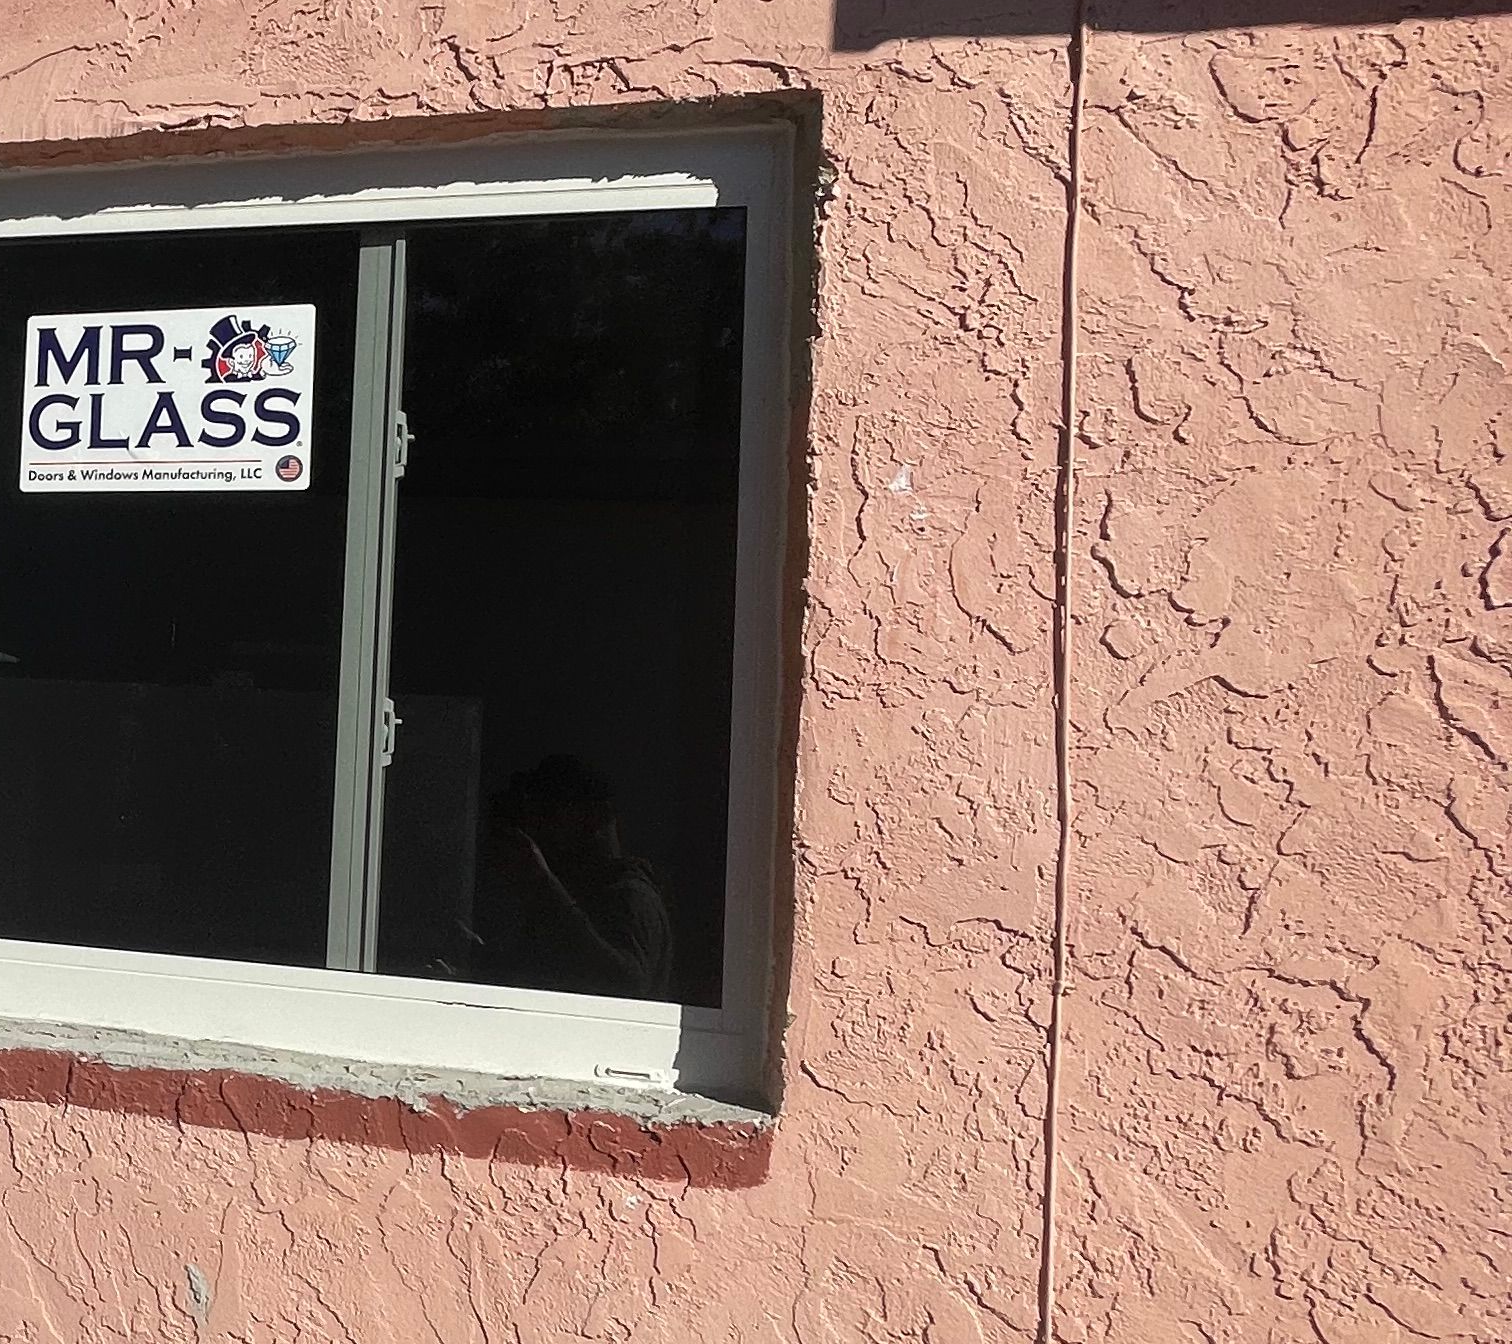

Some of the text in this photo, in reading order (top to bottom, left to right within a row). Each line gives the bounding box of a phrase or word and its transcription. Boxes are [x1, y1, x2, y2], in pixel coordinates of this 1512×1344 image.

[28, 387, 302, 450] GLASS
[28, 467, 262, 483] Doors & Windows Manufacturing, LLC
